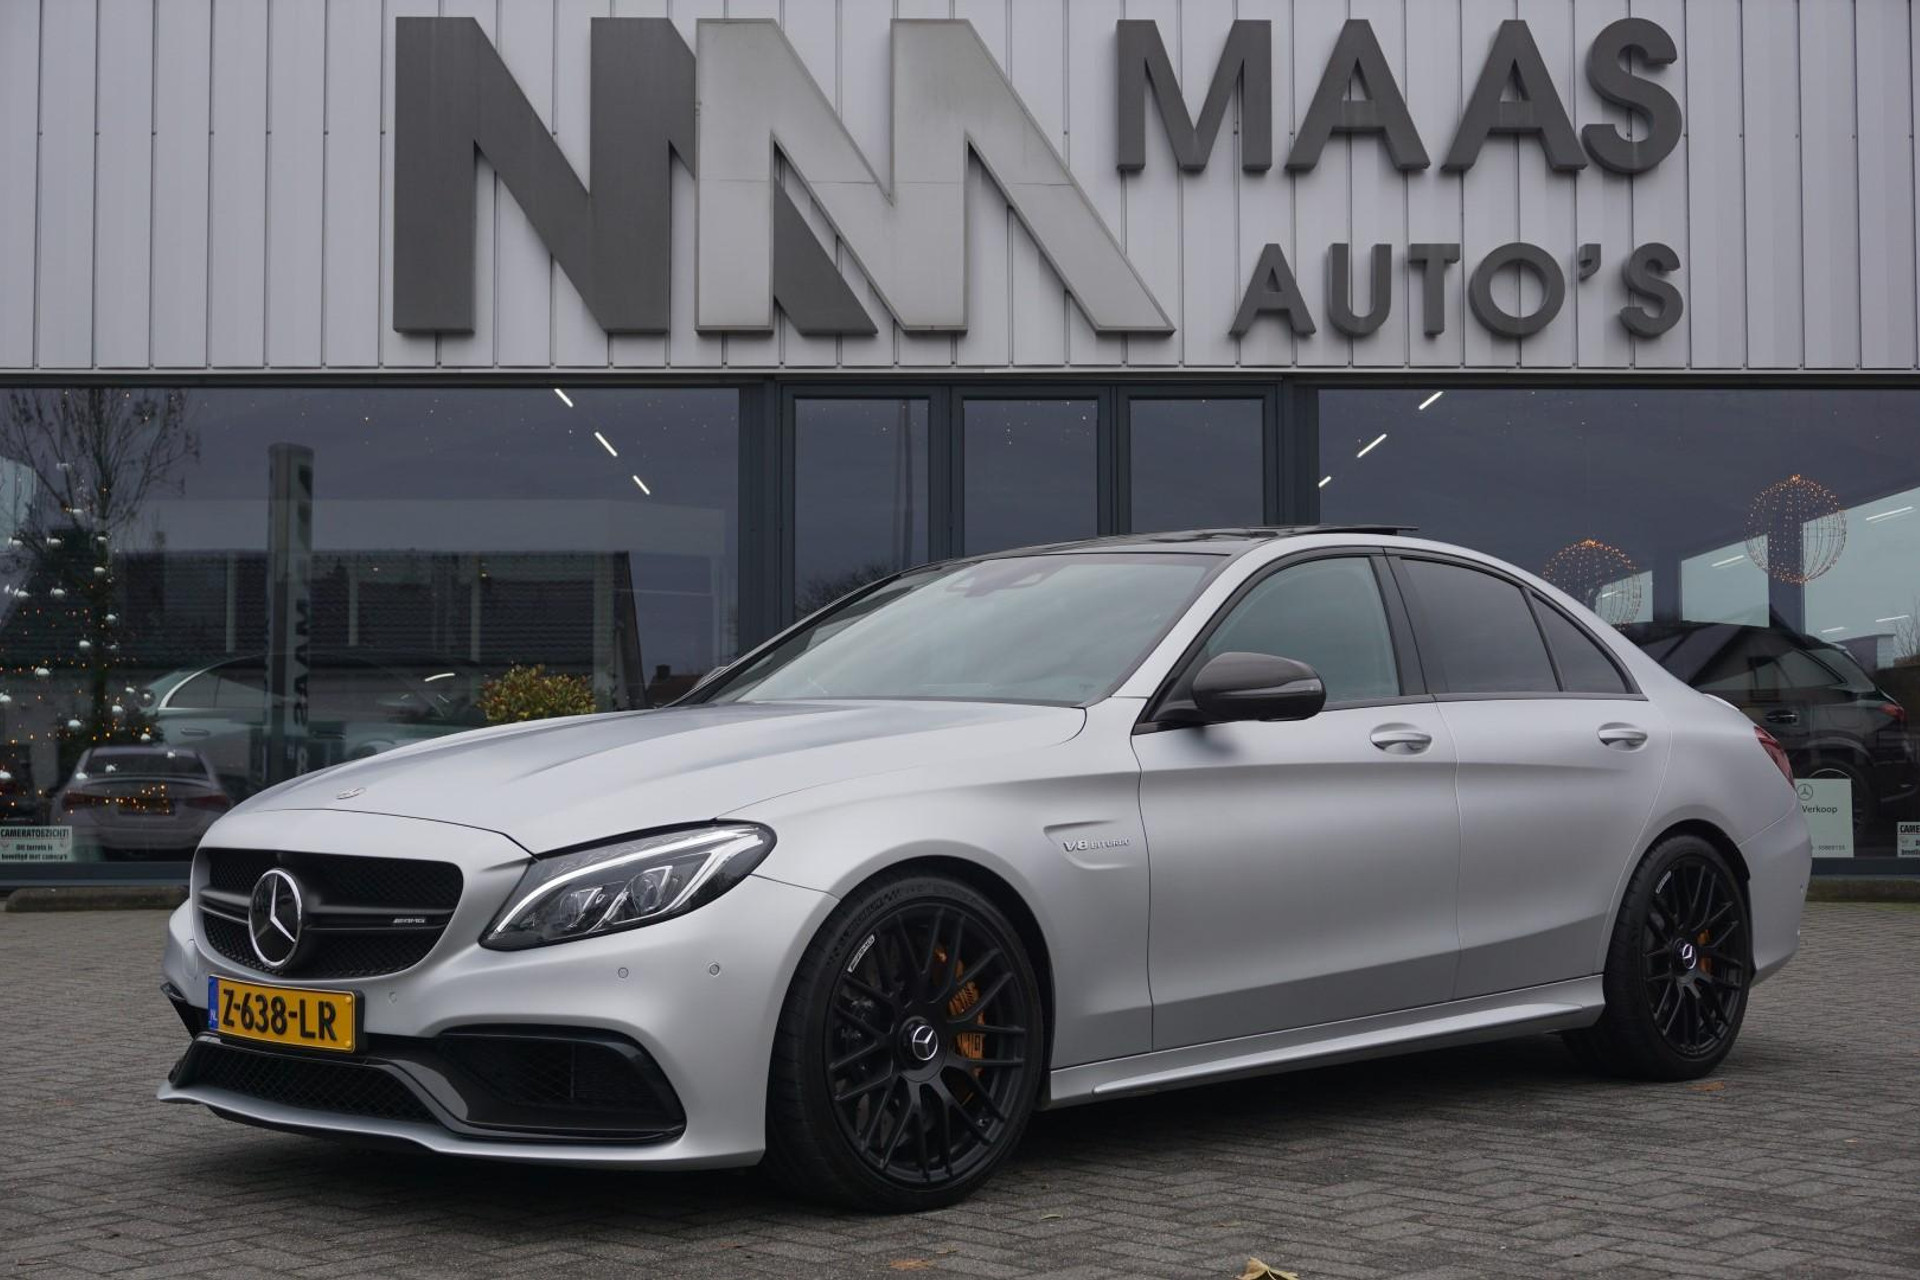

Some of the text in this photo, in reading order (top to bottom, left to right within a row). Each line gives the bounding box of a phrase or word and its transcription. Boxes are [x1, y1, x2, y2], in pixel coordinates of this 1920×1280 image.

[1116, 17, 1683, 174] MAAS
[1801, 805, 1838, 815] Verkoop
[1063, 840, 1088, 852] V8
[223, 988, 337, 1041] Z-638-LR
